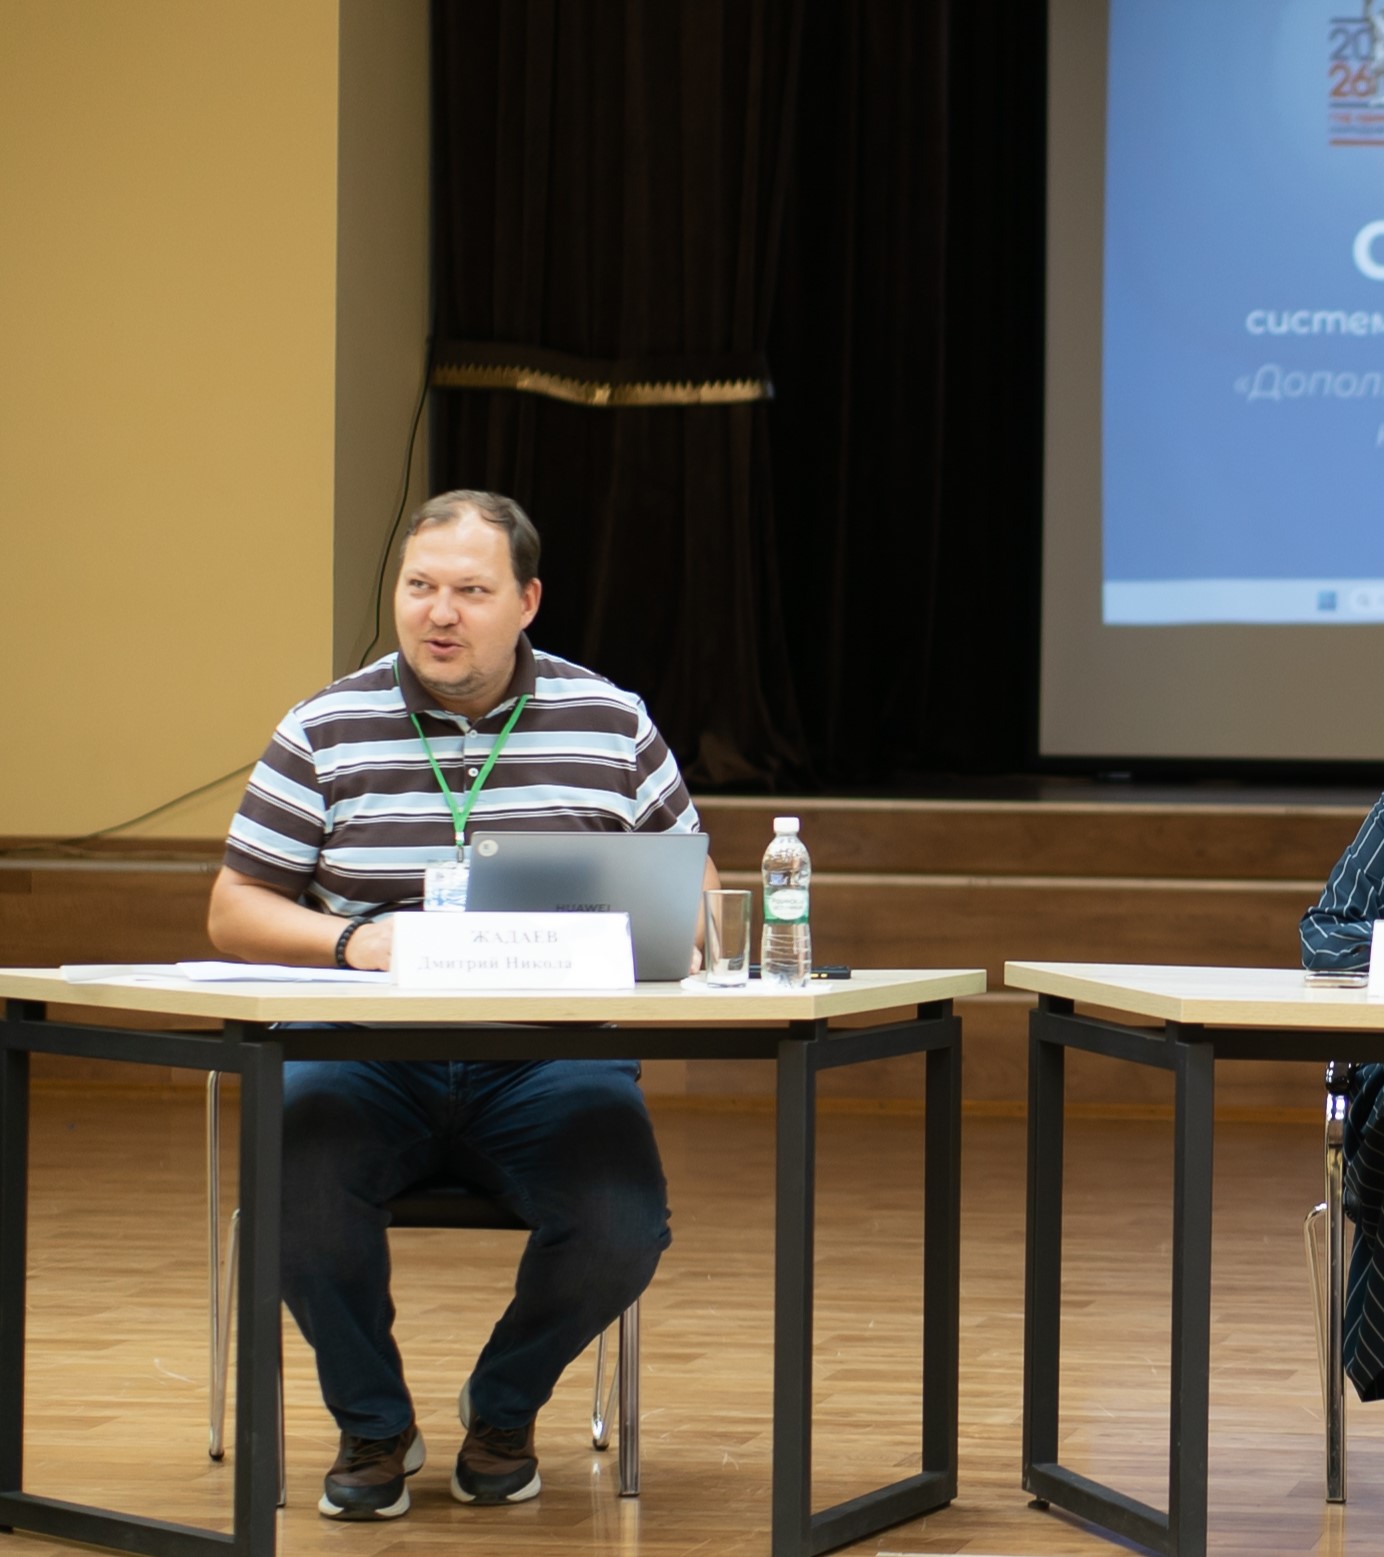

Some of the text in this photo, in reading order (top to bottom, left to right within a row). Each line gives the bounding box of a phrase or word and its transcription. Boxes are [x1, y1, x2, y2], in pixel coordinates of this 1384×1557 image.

[1328, 62, 1377, 98] 26
[555, 903, 611, 912] HUAWEI
[471, 930, 559, 945] ЖАДАЕВ
[416, 956, 499, 973] Дмитрий
